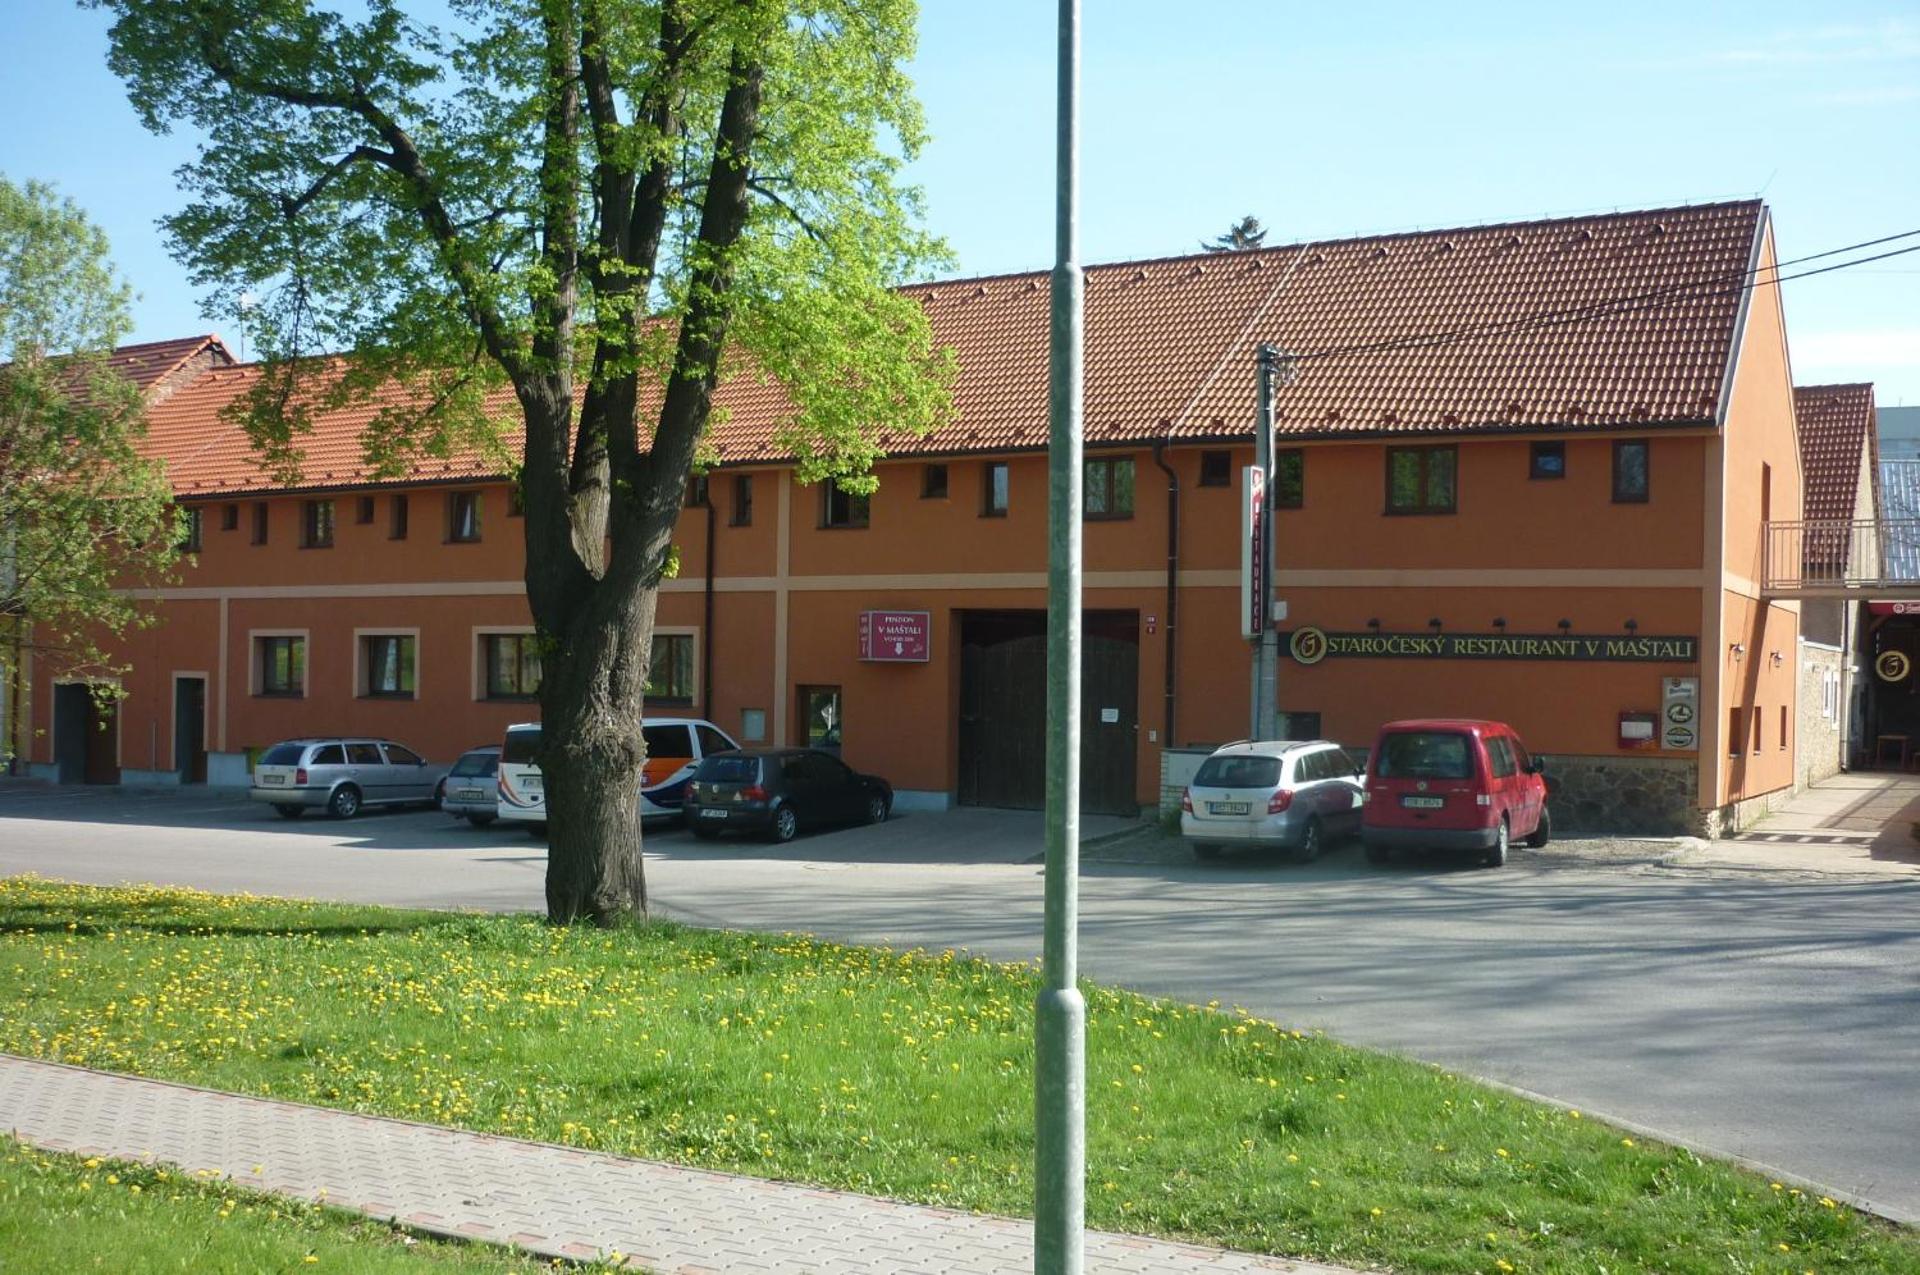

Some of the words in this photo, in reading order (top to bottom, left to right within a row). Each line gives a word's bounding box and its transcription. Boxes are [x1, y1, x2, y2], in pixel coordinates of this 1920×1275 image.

[886, 624, 921, 634] MAŠTALI
[1328, 635, 1445, 654] STAROČESKÝ
[1454, 638, 1580, 656] RESTAURANT
[1585, 640, 1599, 656] V
[1606, 638, 1692, 657] MAŠTALI
